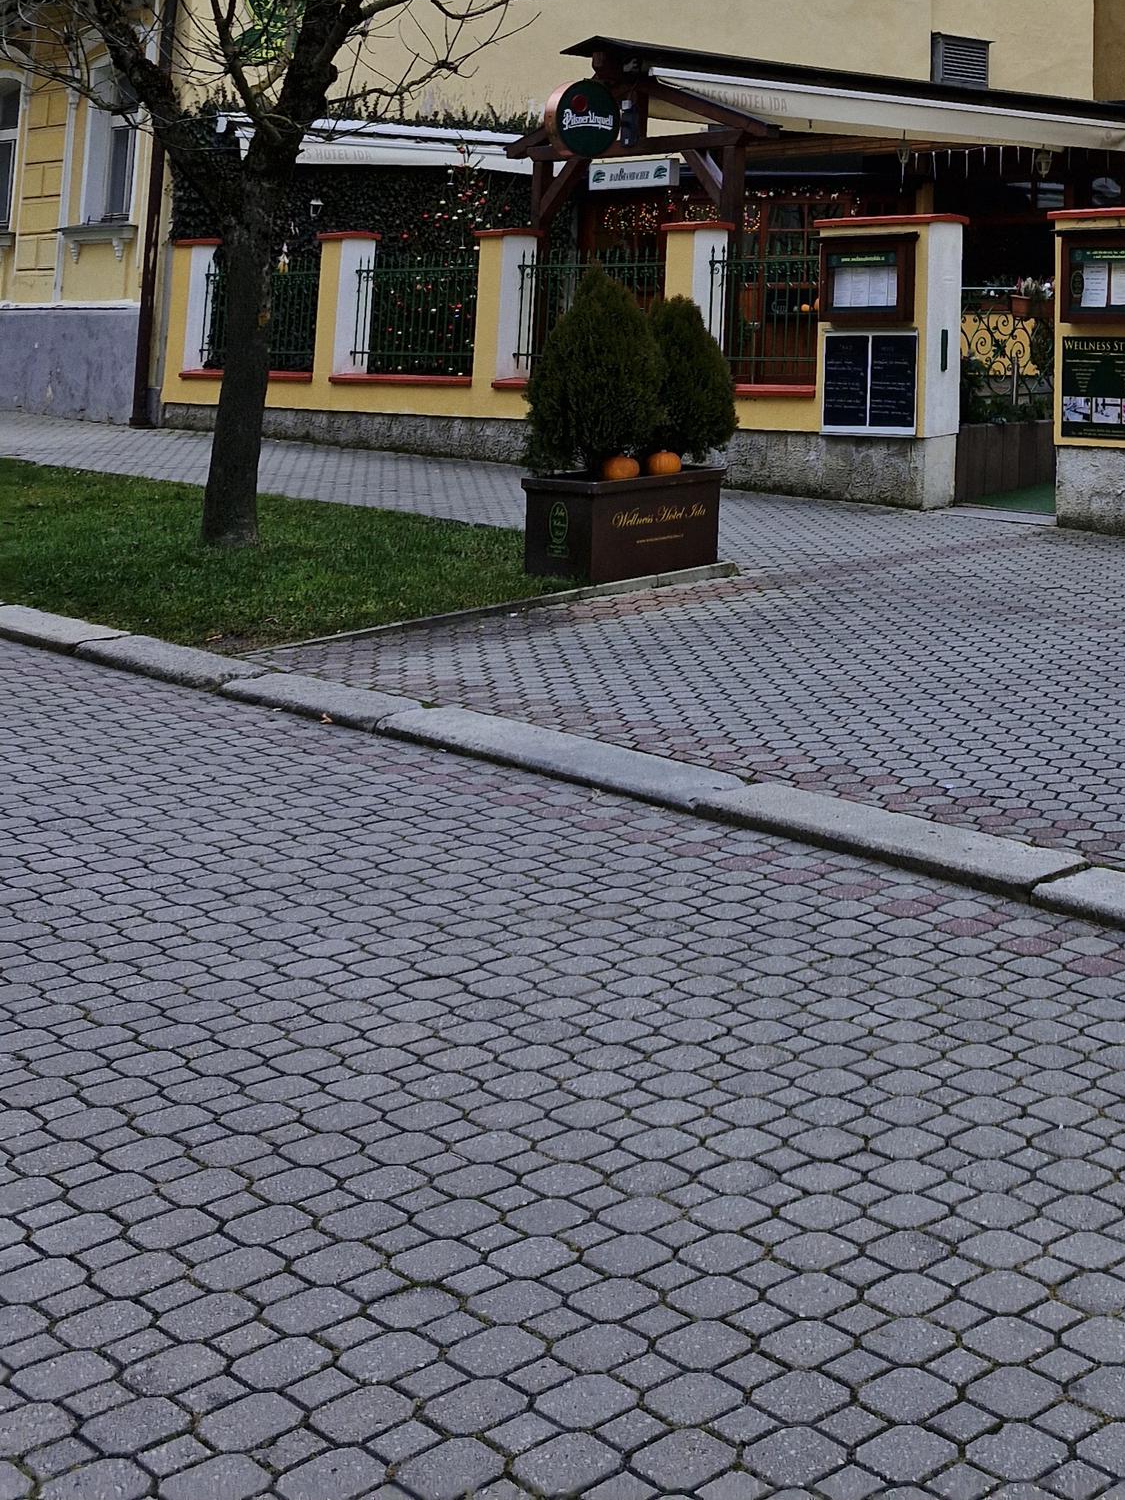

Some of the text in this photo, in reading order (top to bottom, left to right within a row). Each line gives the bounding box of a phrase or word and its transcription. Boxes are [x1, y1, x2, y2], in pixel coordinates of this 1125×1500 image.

[733, 91, 766, 110] HOTEL
[768, 96, 787, 112] IDA
[562, 108, 613, 130] Pilsner Urquell
[1064, 340, 1111, 351] WELLNESS
[612, 502, 706, 528] Wellness Hotel Ida
